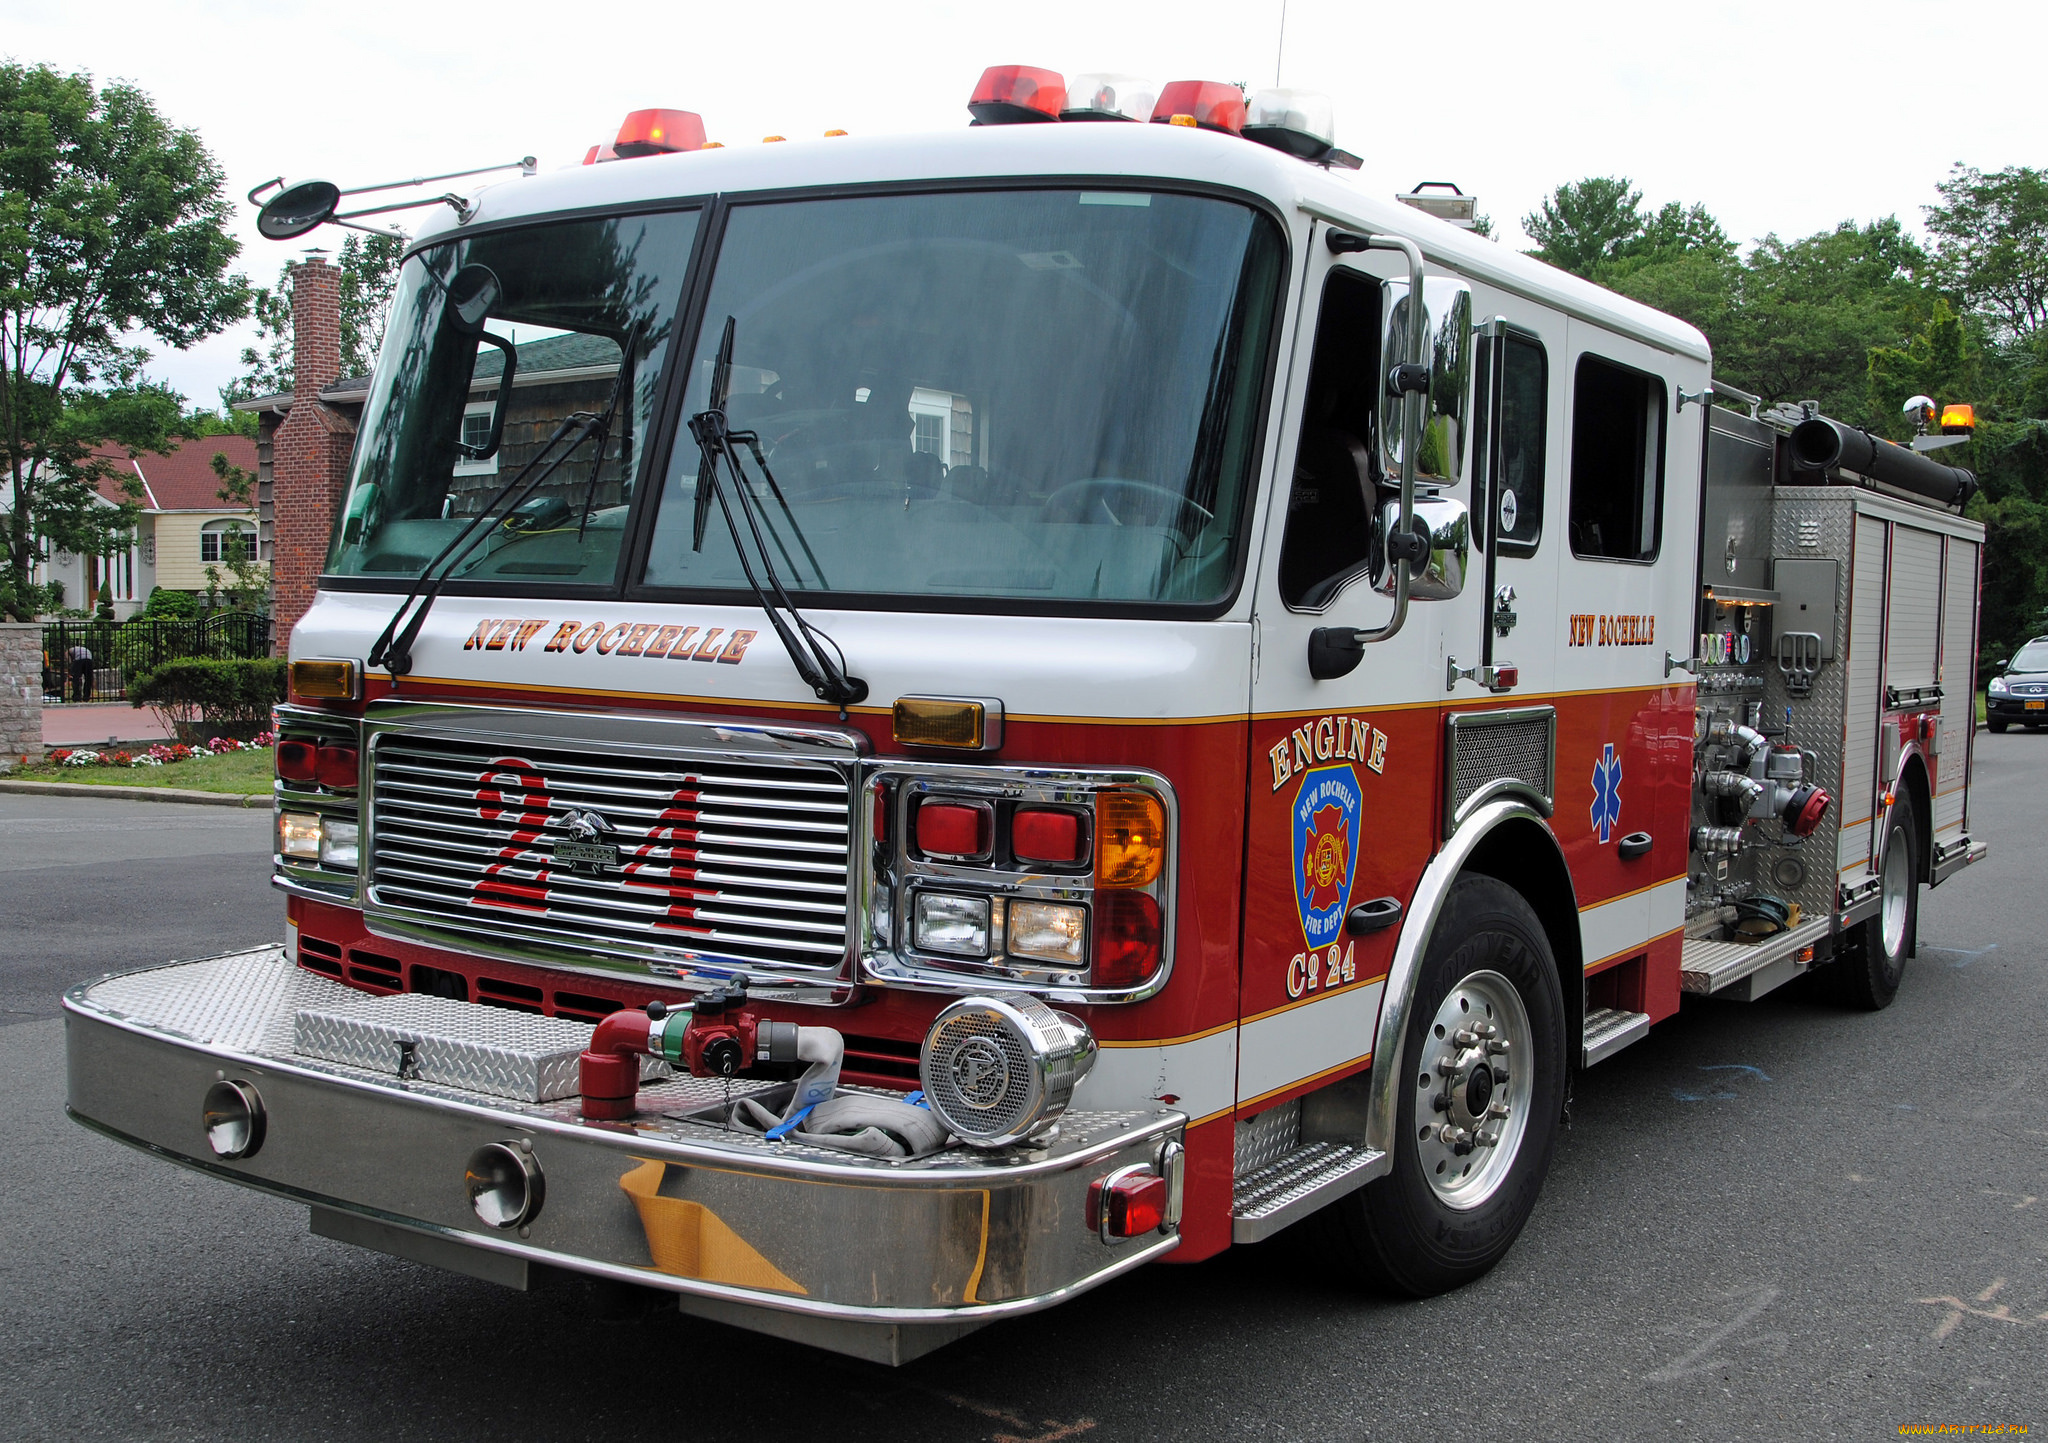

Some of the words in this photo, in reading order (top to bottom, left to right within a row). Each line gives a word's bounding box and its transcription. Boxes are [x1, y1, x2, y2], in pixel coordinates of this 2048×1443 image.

[463, 619, 549, 651] NEW
[544, 621, 758, 665] ROCHELLE
[1569, 614, 1596, 647] NEW
[1598, 614, 1655, 646] ROCHELLE
[1269, 716, 1388, 793] ENGINE
[1300, 787, 1318, 822] NEW
[1320, 780, 1356, 813] ROCHELLE
[1305, 914, 1322, 935] FIRE
[1324, 904, 1342, 934] DEPT
[1325, 940, 1355, 987] 24
